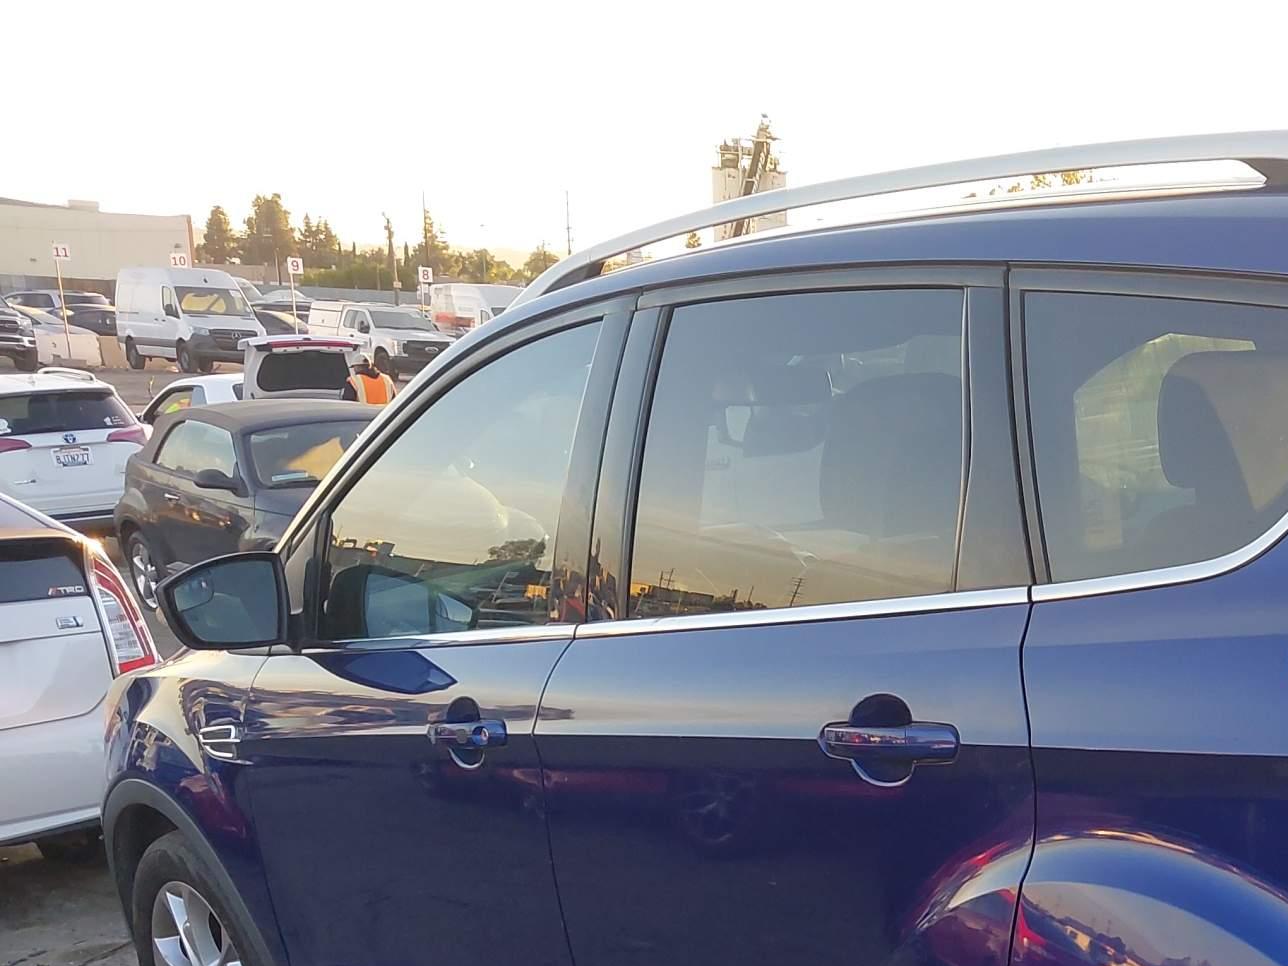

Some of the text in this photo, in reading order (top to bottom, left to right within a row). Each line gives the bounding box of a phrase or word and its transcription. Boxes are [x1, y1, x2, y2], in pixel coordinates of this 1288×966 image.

[54, 247, 69, 258] 11
[171, 256, 186, 266] 10
[291, 260, 299, 272] 9
[422, 269, 429, 281] 8
